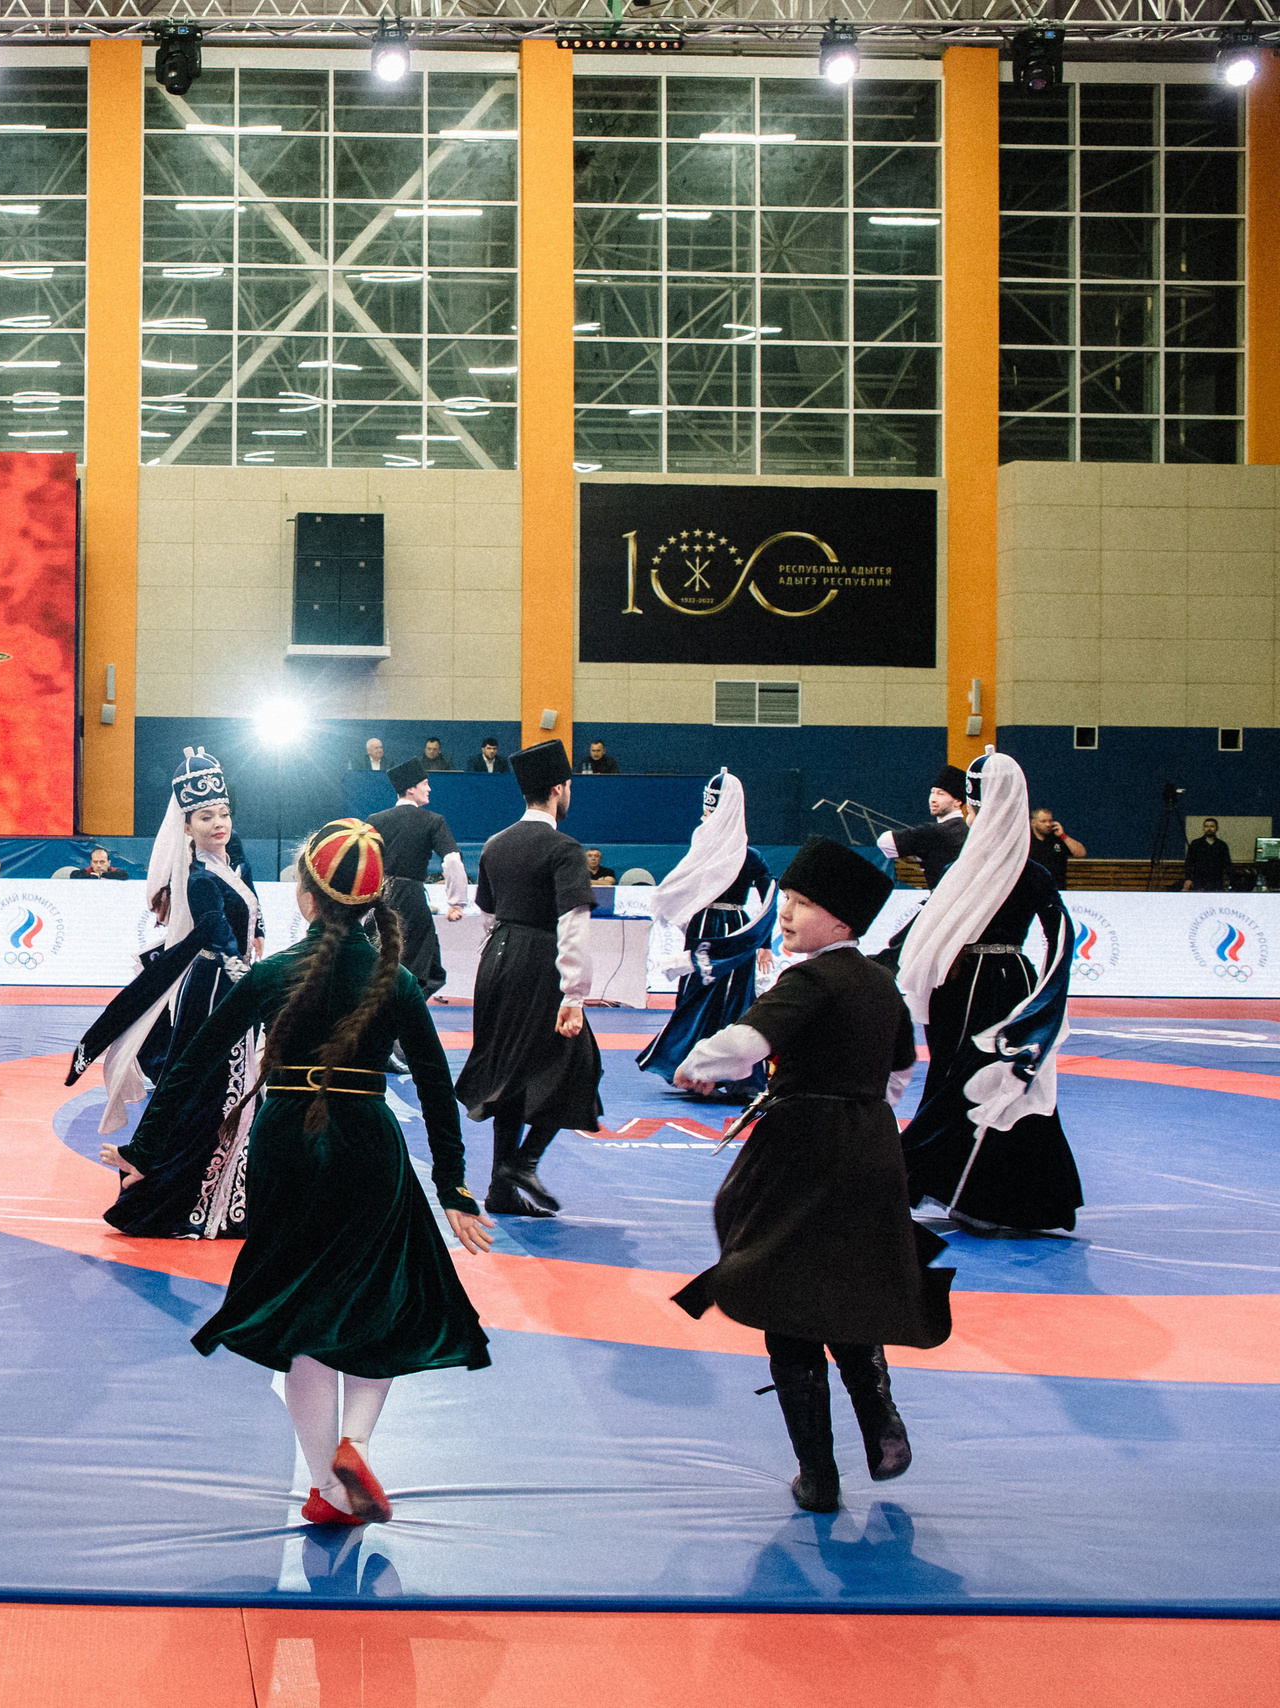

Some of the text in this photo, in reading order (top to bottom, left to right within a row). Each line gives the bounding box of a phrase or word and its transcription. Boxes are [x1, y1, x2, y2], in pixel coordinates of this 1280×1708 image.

[779, 564, 892, 575] РЕСПУБЛИКА АДЫГЕЯ
[779, 576, 891, 586] АДЫГЭ РЕСПУБЛИК
[22, 893, 60, 916] КОМИТЕТ
[50, 918, 65, 955] РОССИИ
[1072, 905, 1111, 928] КОМИТЕТ
[1218, 907, 1260, 930] КОМИТЕТ
[1256, 931, 1269, 968] РОССИИ
